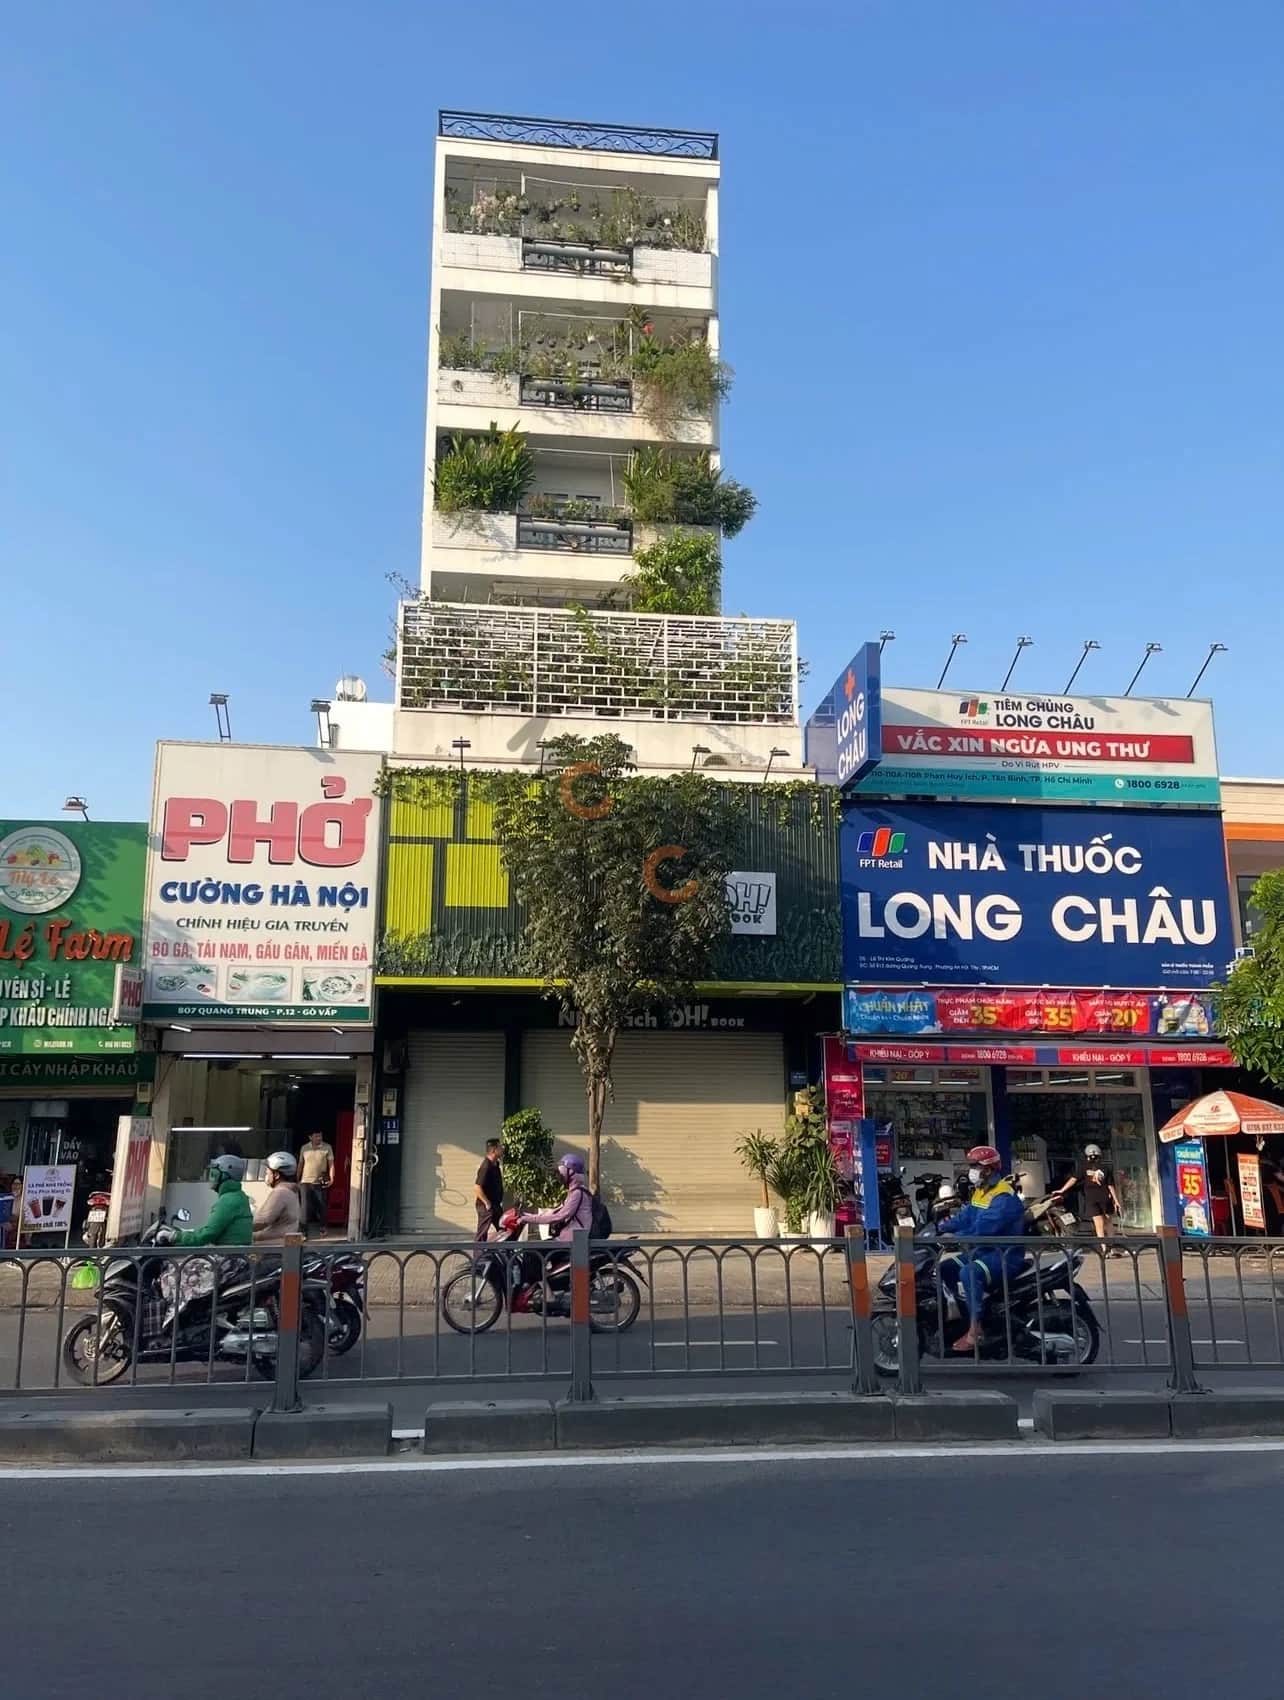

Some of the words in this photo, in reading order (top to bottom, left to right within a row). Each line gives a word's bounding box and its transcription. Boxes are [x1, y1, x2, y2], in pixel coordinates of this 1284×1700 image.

[993, 698, 1022, 711] TIÊM
[837, 692, 865, 745] LONG
[995, 714, 1042, 728] LONG
[1046, 713, 1095, 730] CHÂU
[838, 727, 866, 780] CHÂU
[897, 730, 942, 752] VẮC
[948, 736, 984, 753] XIN
[990, 735, 1051, 755] NGỪA
[1056, 741, 1101, 757] UNG
[1106, 741, 1150, 758] THƯ
[1002, 760, 1013, 768] Do
[1042, 761, 1060, 769] HPV
[1072, 777, 1093, 785] Minh
[1126, 780, 1152, 789] 1800
[1154, 780, 1180, 790] 6928
[161, 775, 373, 868] PHỞ
[859, 858, 876, 869] FPT
[877, 858, 903, 870] Retail
[928, 832, 1007, 872] NHÀ
[1018, 832, 1142, 875] THUỐC
[160, 876, 264, 905] CƯỜNG
[269, 880, 310, 907] HÀ
[317, 881, 369, 914] NỘI
[176, 915, 222, 929] CHÍNH
[226, 917, 260, 932] HIỆU
[265, 920, 289, 931] GIA
[857, 891, 1023, 942] LONG
[1051, 886, 1217, 946] CHÂU
[44, 919, 134, 962] Farm
[197, 939, 217, 958] TÁI
[352, 943, 368, 961] GÀ
[47, 1002, 88, 1027] CHÍNH
[198, 1008, 234, 1016] QUANG
[236, 1008, 269, 1016] TRUNG
[276, 1008, 295, 1016] P.12
[302, 1006, 317, 1016] GÒ
[319, 1005, 337, 1016] VẤP
[711, 1017, 745, 1027] BOOK
[1110, 1053, 1125, 1063] GÓP
[10, 1060, 41, 1076] CÂY
[45, 1059, 91, 1080] NHẬP
